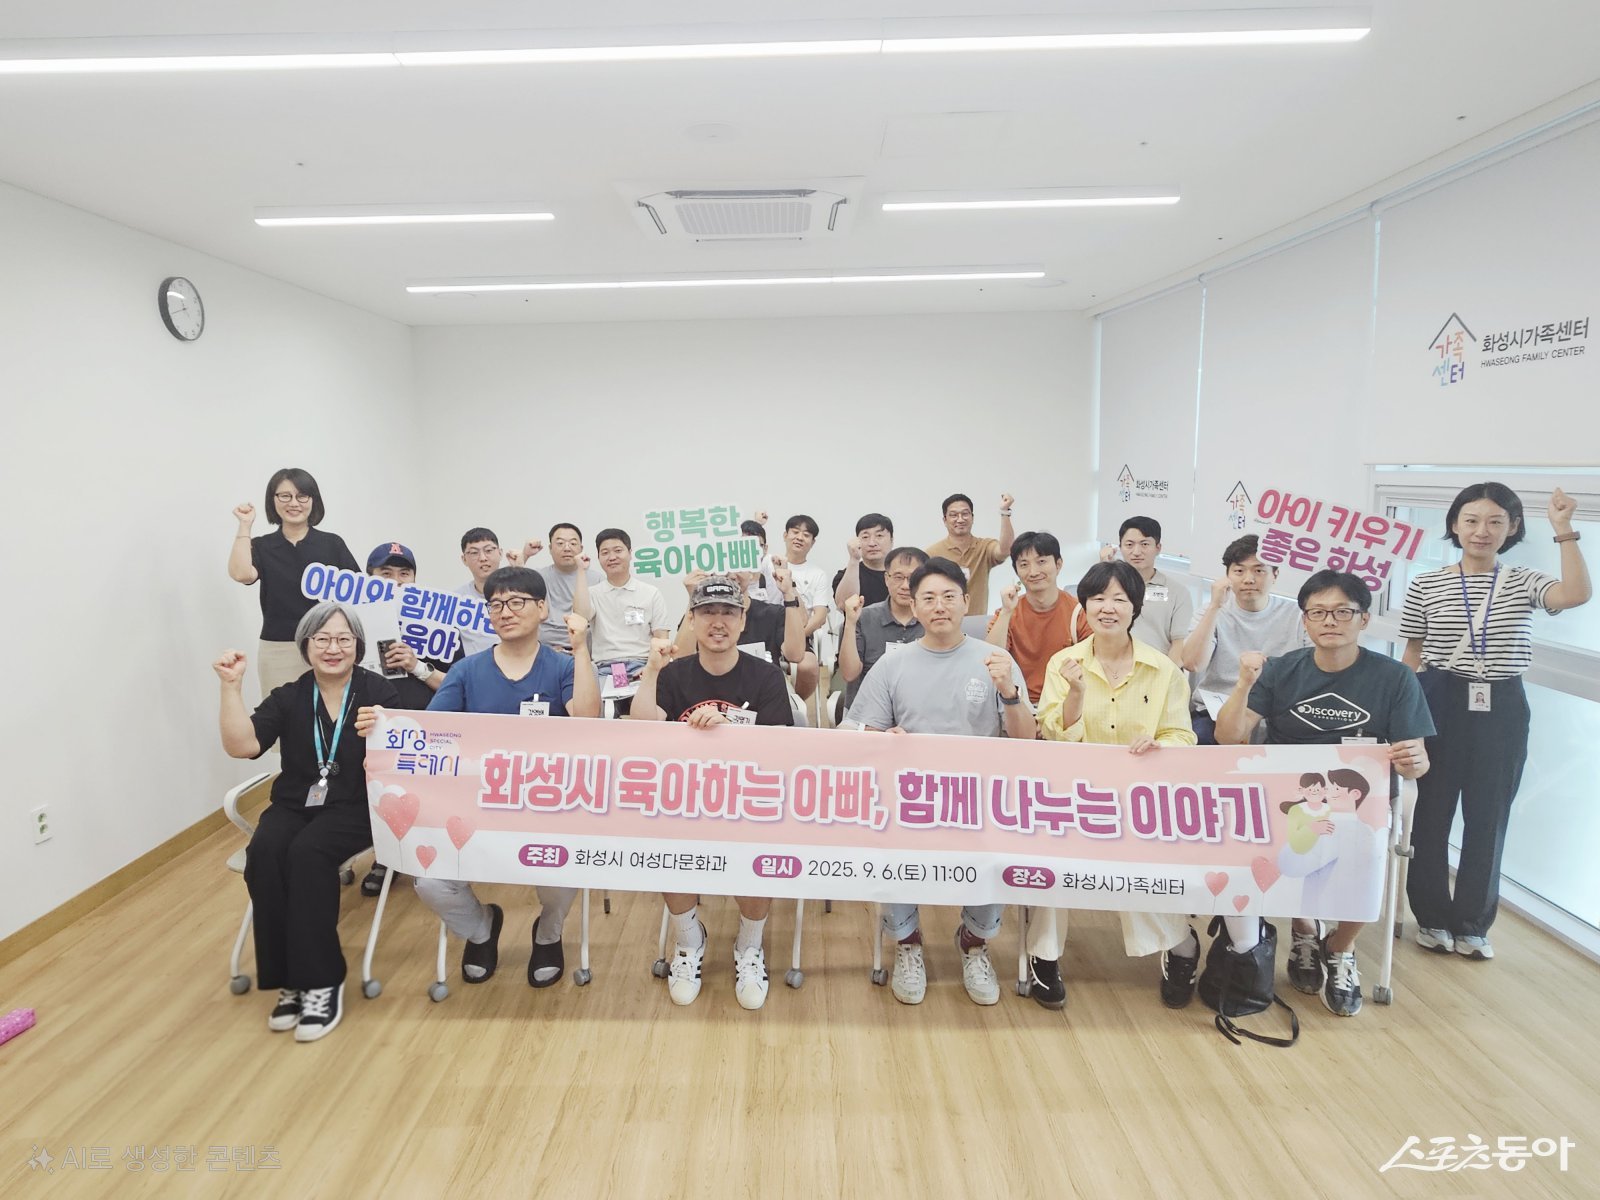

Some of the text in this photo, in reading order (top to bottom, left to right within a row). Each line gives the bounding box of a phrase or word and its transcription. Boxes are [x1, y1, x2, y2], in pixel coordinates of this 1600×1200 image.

[1435, 331, 1465, 363] 가족
[1481, 317, 1590, 353] 화성시가족센터
[1432, 358, 1465, 386] 센터
[1481, 346, 1586, 368] HWASEONG FAMILY CENTER
[645, 505, 741, 543] 행복한
[1257, 489, 1425, 561] 아이 키우기
[388, 542, 404, 555] A
[633, 539, 760, 578] 육아아빠
[1261, 528, 1322, 572] 좋은
[399, 621, 456, 660] 육아
[482, 752, 1266, 839] 화성시 육아하는 아빠, 함께 나누는 이야기
[526, 846, 560, 865] 주최
[575, 849, 623, 868] 화성시
[630, 851, 727, 872] 여성다문화과
[760, 857, 794, 876] 일시
[808, 860, 857, 878] 2025.
[863, 861, 877, 879] 9.
[932, 865, 977, 883] 11:00
[1011, 868, 1048, 887] 장소
[1062, 872, 1185, 896] 화성시가족센터
